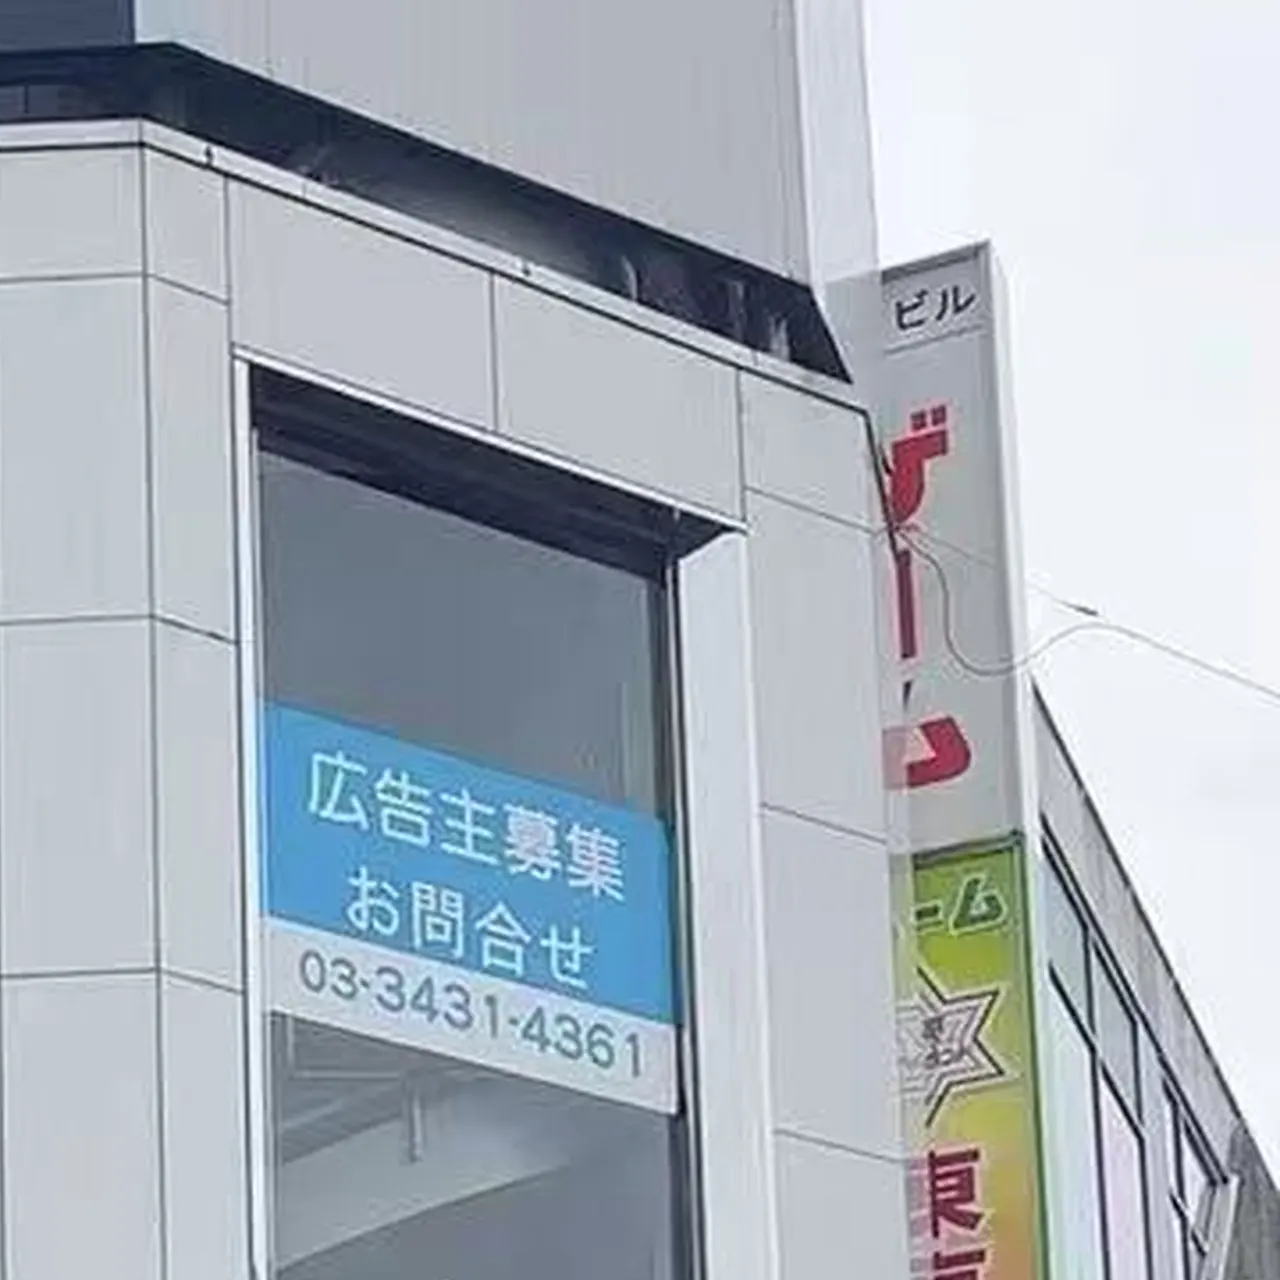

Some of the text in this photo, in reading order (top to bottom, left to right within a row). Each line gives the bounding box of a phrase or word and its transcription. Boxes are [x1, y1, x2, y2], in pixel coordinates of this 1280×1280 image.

[894, 282, 977, 332] ビル
[308, 749, 625, 901] 広告主募集
[346, 866, 595, 990] お問合せ
[298, 948, 645, 1078] 03-3431-4361
